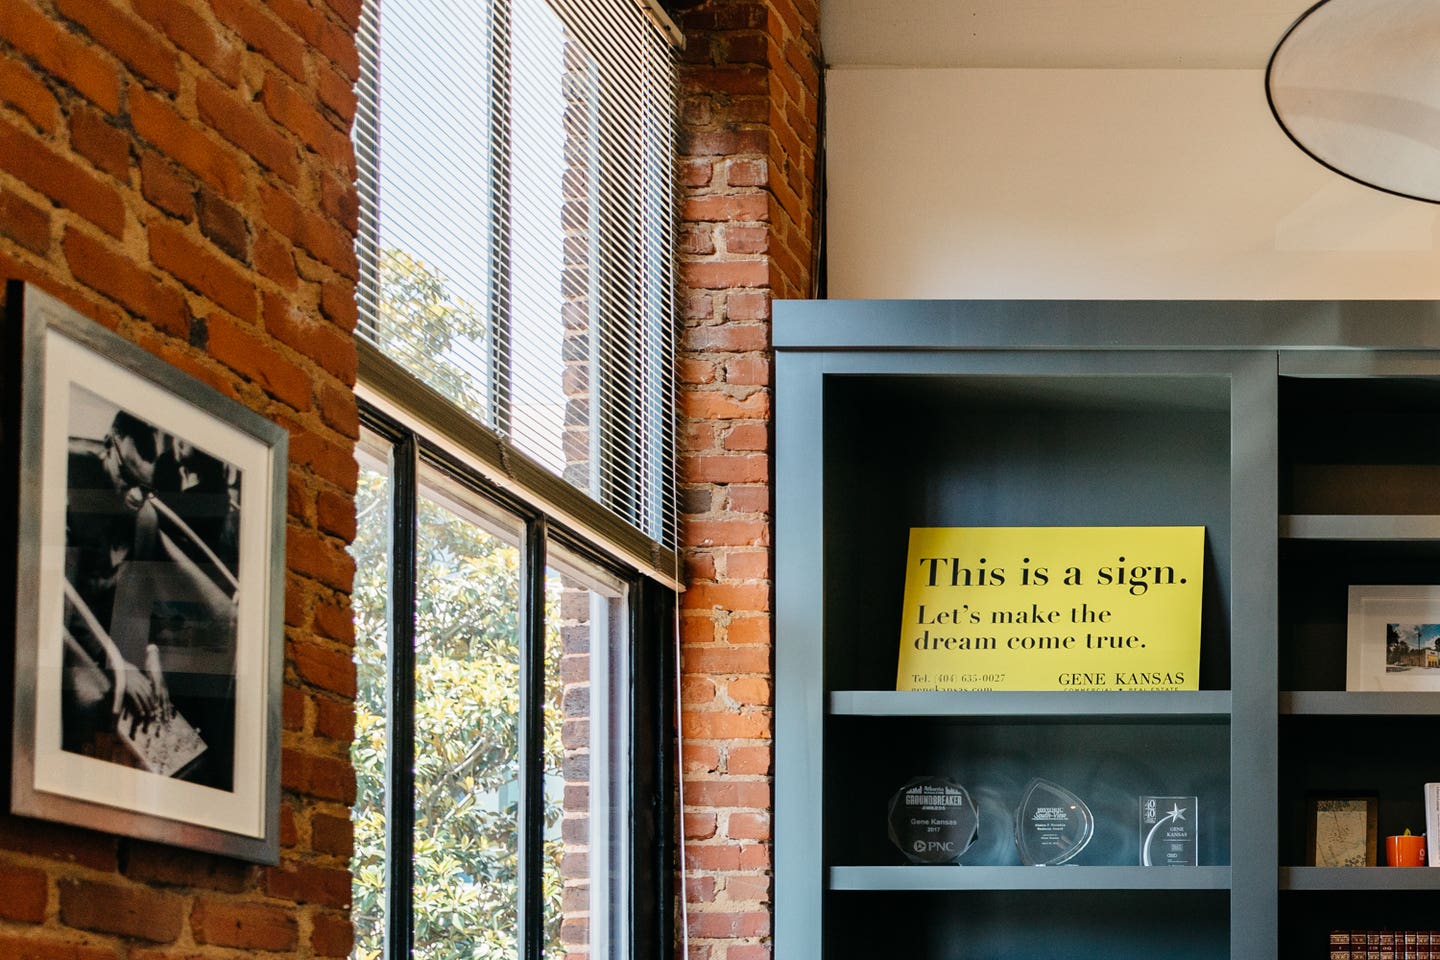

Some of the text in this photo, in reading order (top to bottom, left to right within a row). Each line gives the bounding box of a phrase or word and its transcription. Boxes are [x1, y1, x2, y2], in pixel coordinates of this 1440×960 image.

[919, 555, 1188, 596] This is a sign.
[916, 603, 1112, 625] Let’s make the
[913, 630, 1147, 651] dream come true.
[911, 674, 930, 683] Tel.
[961, 673, 1006, 683] 635-0027
[1058, 672, 1185, 686] GENE KANSAS
[905, 795, 962, 806] GROUNDBREAKER
[928, 842, 954, 851] PNC
